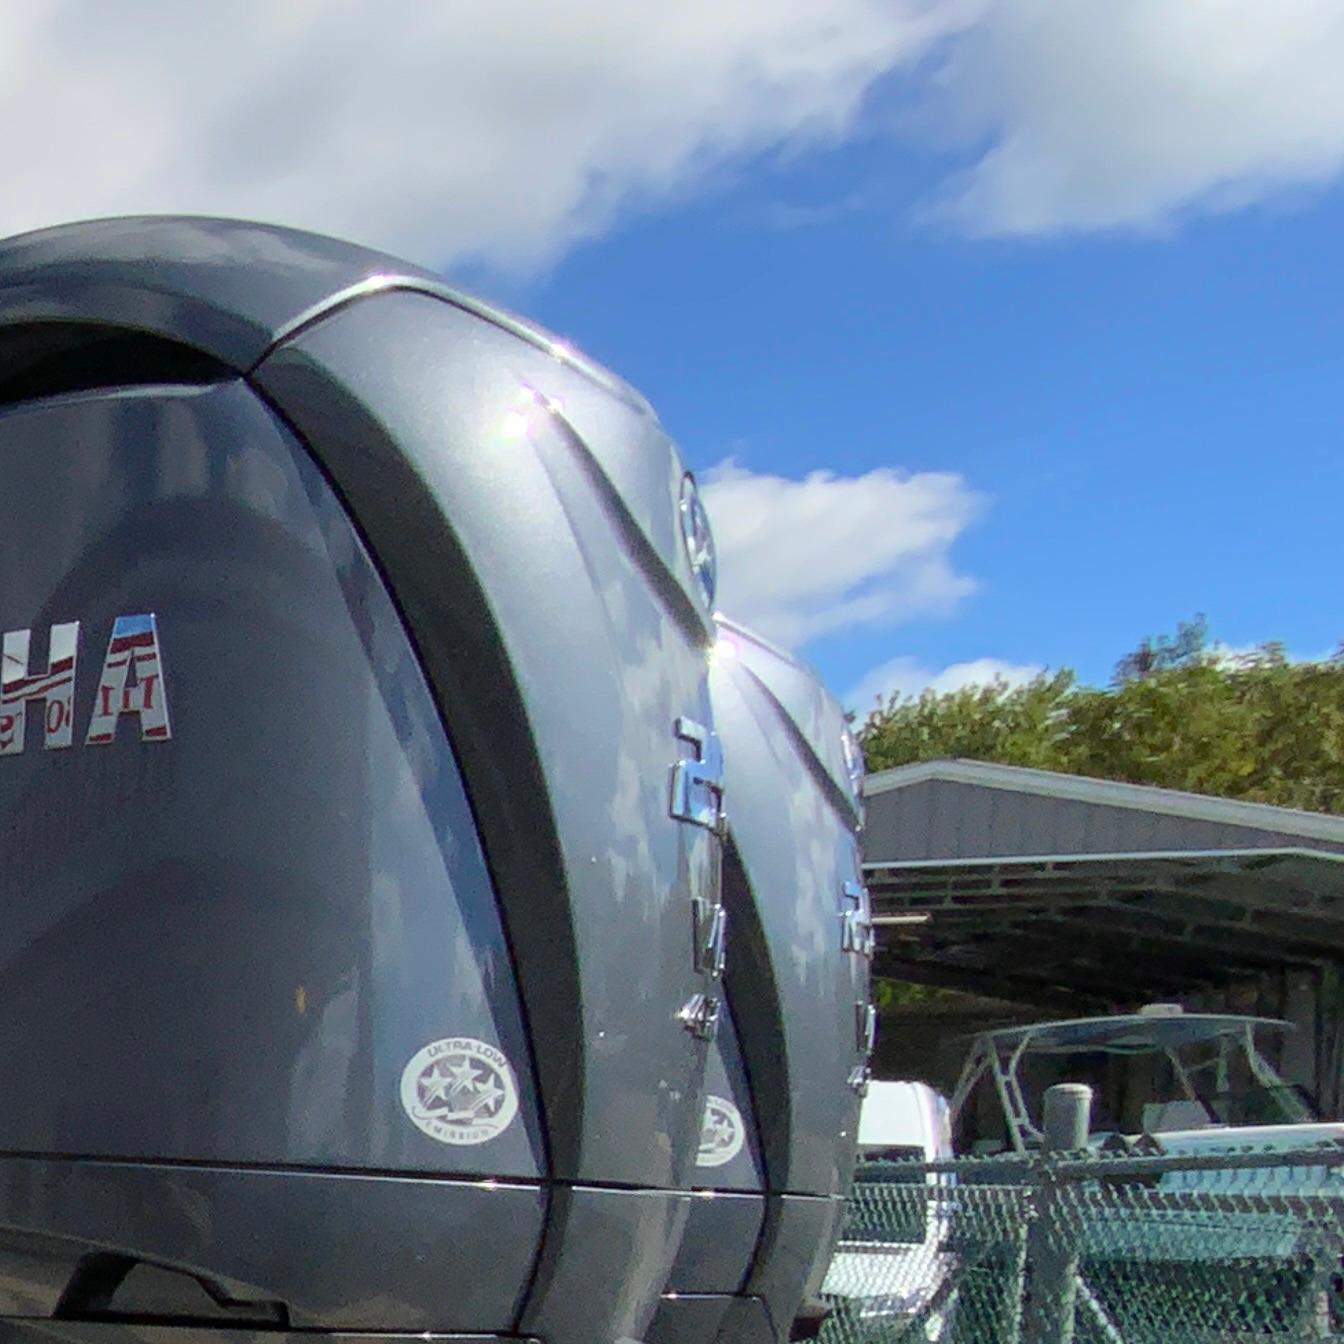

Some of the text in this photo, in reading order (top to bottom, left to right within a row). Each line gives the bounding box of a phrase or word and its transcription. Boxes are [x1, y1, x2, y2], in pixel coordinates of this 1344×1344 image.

[427, 1039, 509, 1068] ULTRA LOW
[424, 1119, 490, 1140] EMISSION
